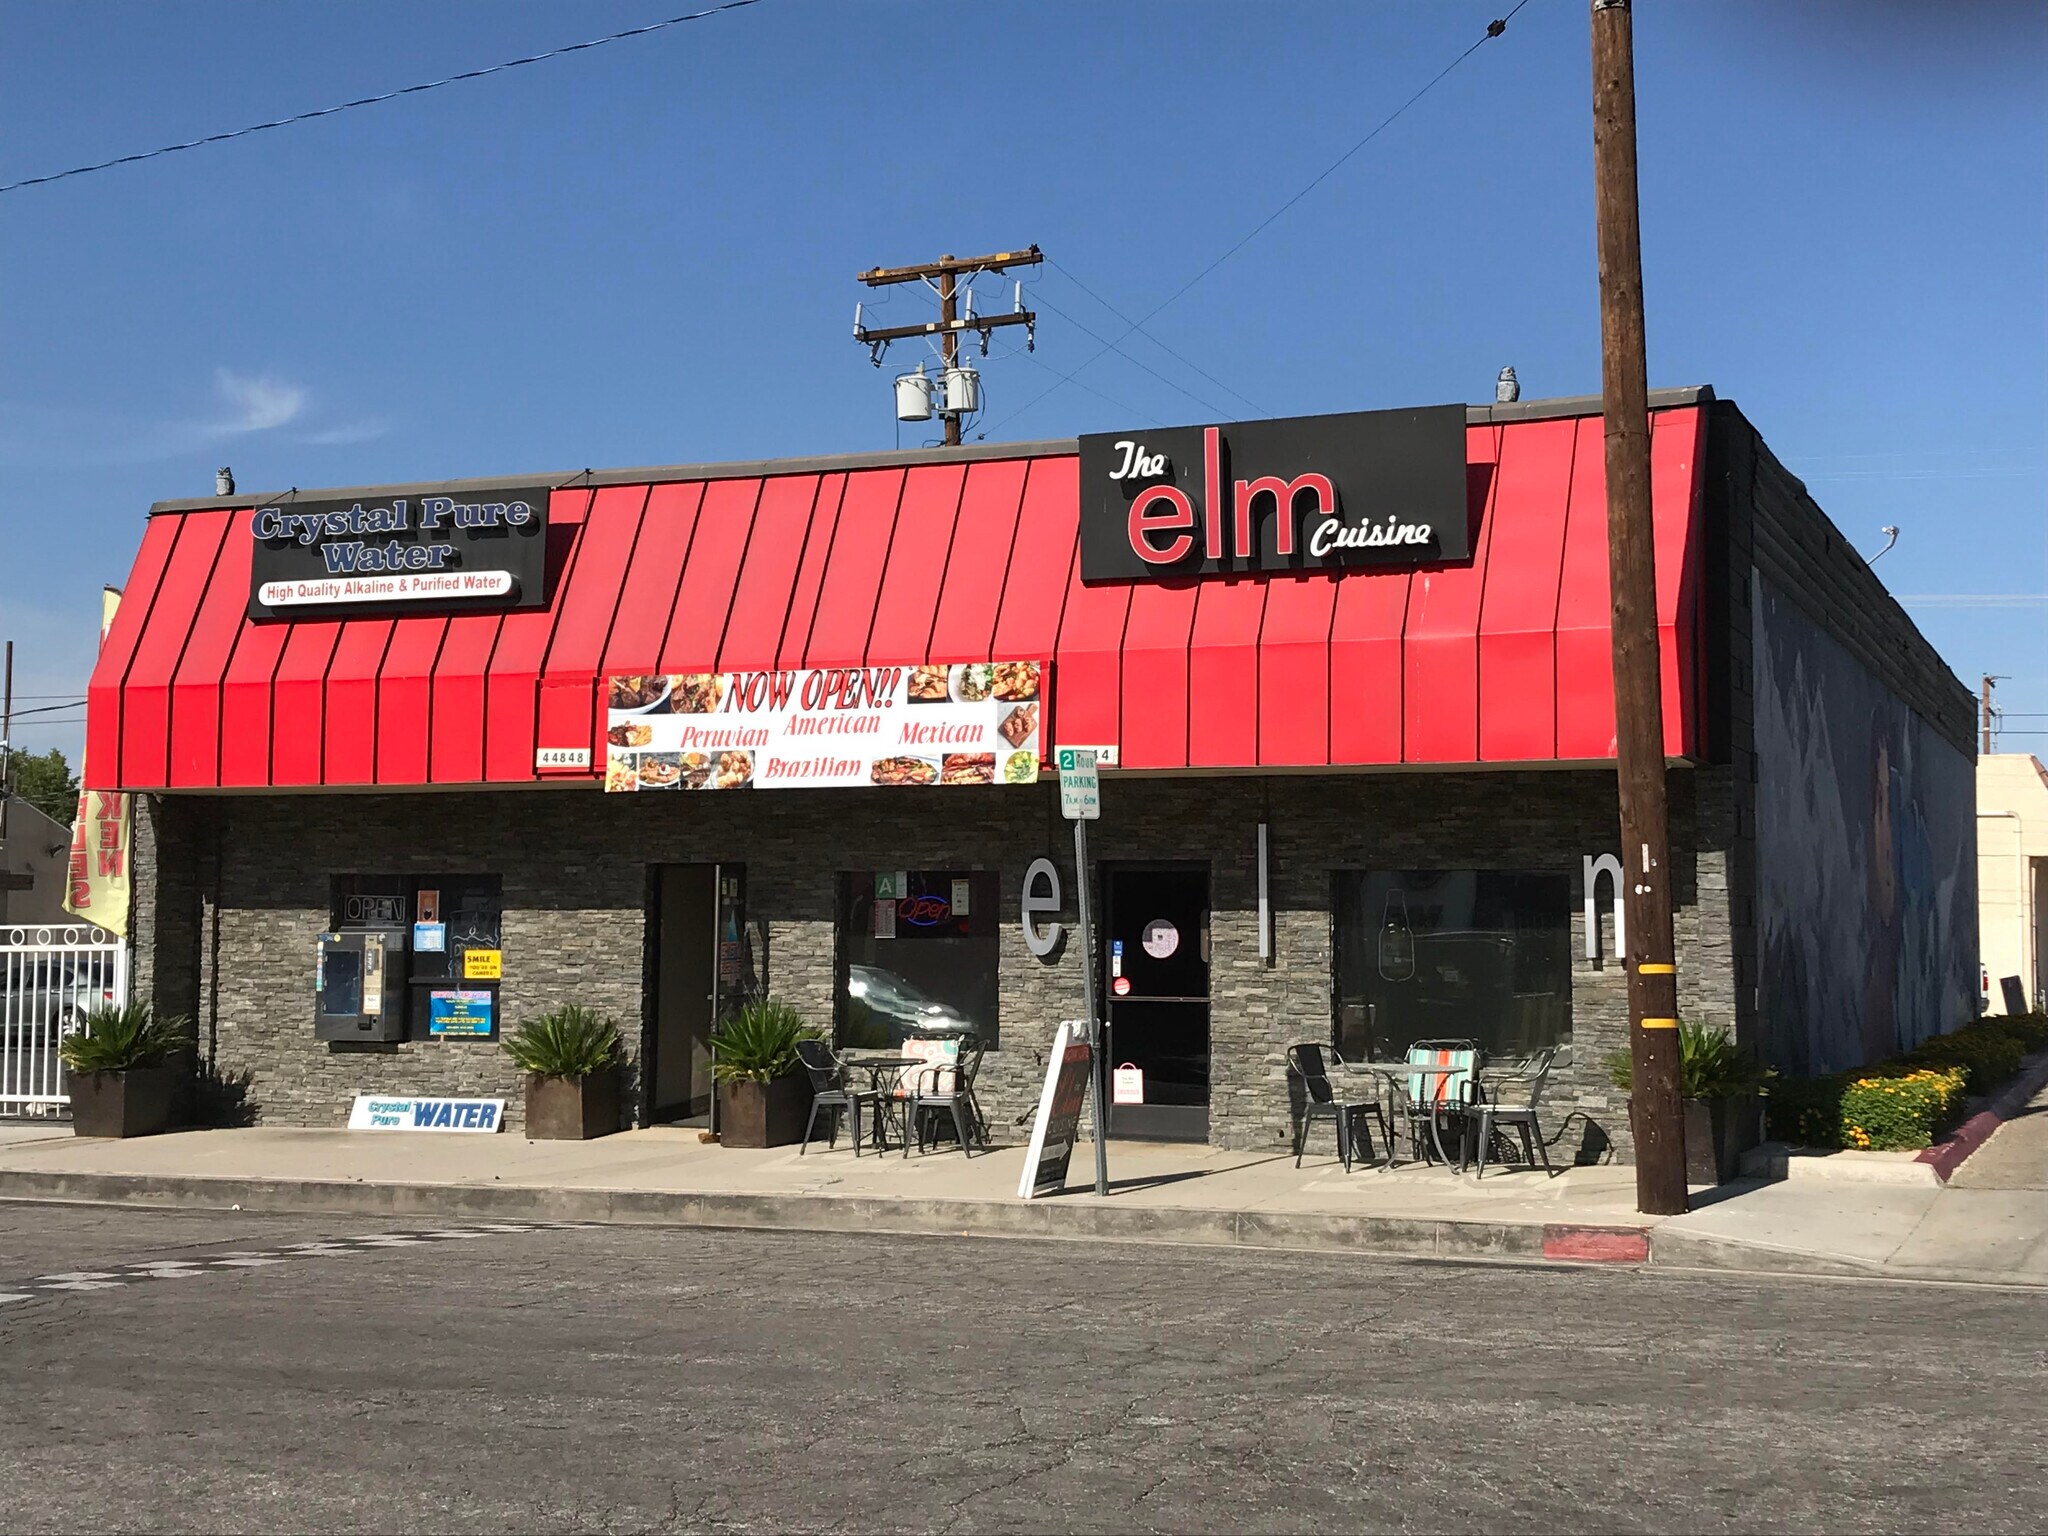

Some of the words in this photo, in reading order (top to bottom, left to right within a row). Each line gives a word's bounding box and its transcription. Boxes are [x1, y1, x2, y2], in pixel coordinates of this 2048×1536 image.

[1108, 440, 1166, 480] The
[1127, 427, 1335, 564] elm
[250, 500, 407, 544] Crystal
[420, 497, 530, 529] Pure
[1309, 515, 1432, 558] Cuisine
[320, 540, 452, 573] Water
[267, 586, 294, 601] High
[297, 582, 341, 598] Quality
[344, 581, 394, 595] Alkaline
[399, 578, 408, 592] &
[412, 577, 460, 591] Purified
[463, 576, 502, 589] Water
[723, 671, 796, 713] NOW
[801, 667, 901, 711] OPEN!!
[782, 713, 881, 736] American
[898, 721, 984, 745] Mexican
[680, 725, 769, 749] Peruvian
[543, 752, 584, 763] 44848
[764, 756, 861, 779] Brazilian
[1063, 753, 1072, 768] 2
[1076, 757, 1094, 768] HOUR
[1063, 776, 1096, 789] PARKING
[878, 877, 892, 894] A
[347, 898, 403, 919] OPEN
[898, 897, 950, 920] Open
[368, 1101, 411, 1113] Crystal
[413, 1102, 497, 1128] WATER
[371, 1115, 400, 1126] Pure
